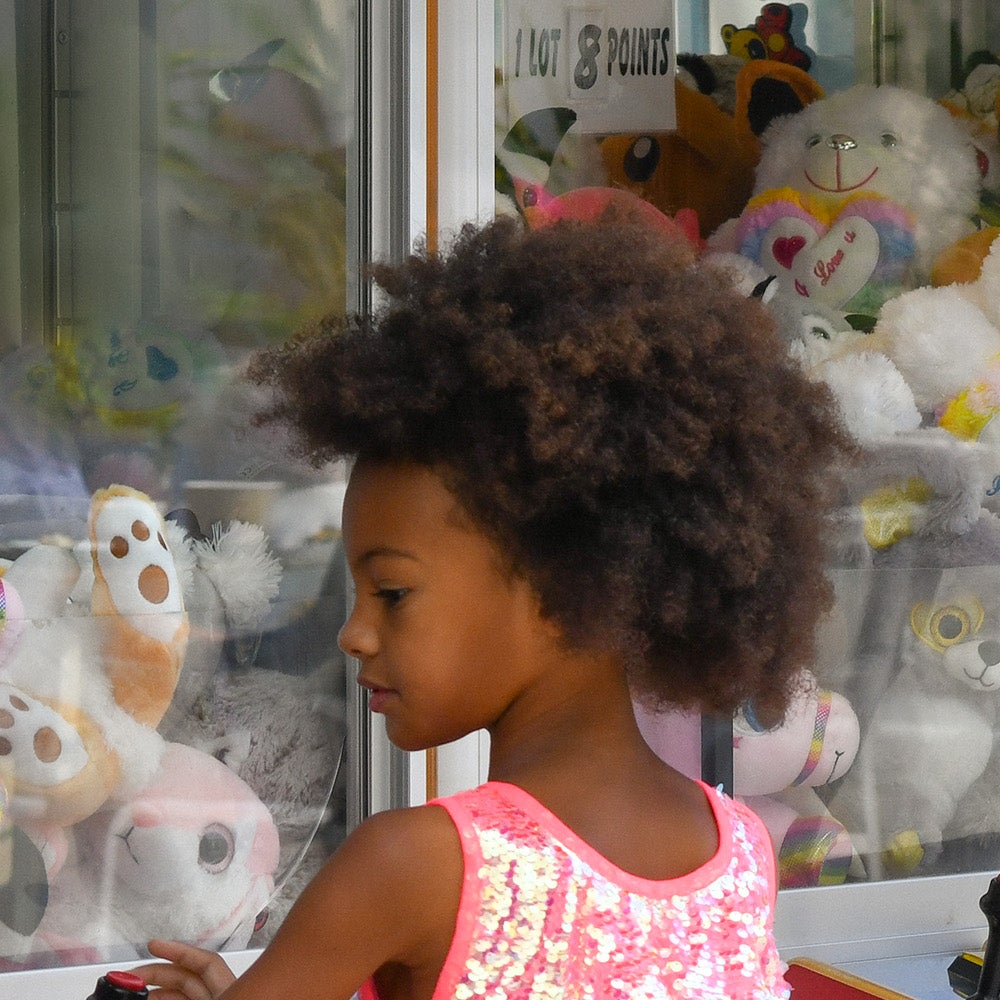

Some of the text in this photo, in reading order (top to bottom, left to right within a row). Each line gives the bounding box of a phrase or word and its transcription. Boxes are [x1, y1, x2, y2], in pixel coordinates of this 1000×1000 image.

[529, 28, 561, 77] LOT
[574, 24, 601, 90] 8
[607, 27, 670, 76] POINTS
